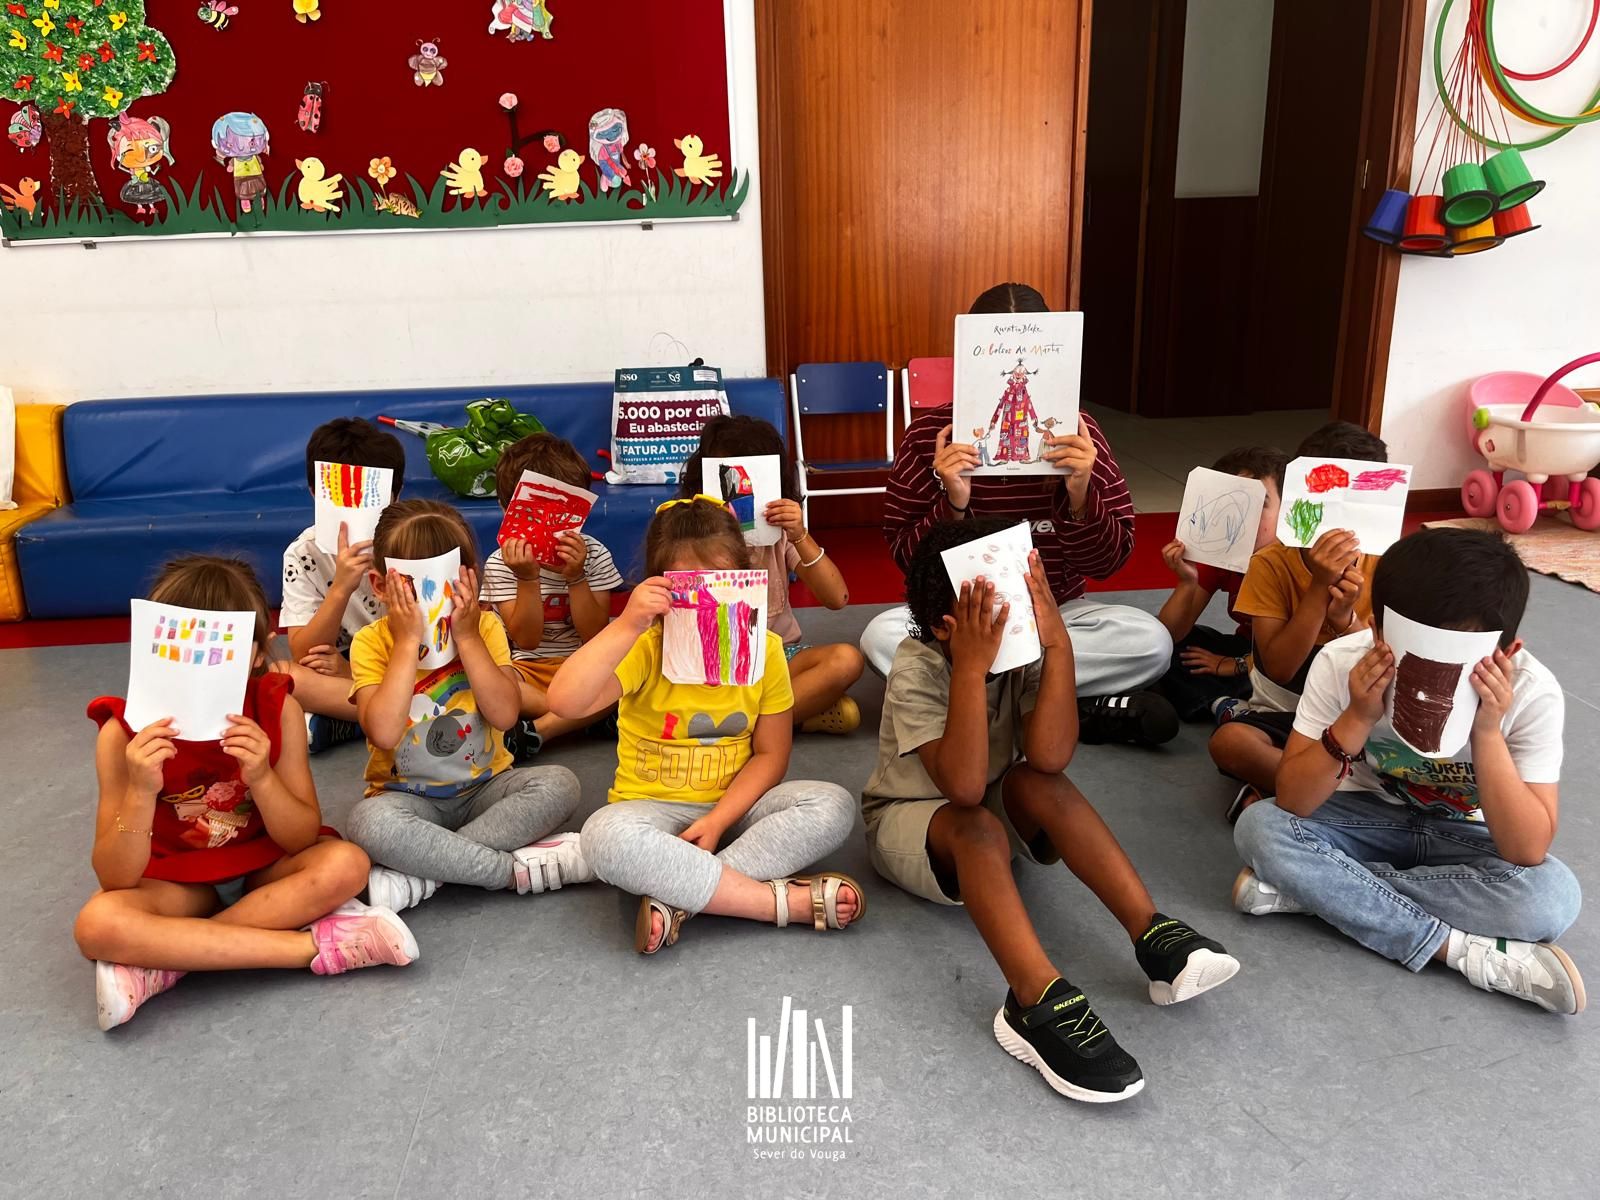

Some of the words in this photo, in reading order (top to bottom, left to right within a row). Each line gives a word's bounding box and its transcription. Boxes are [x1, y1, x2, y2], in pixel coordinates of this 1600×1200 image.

[1020, 323, 1043, 334] Blake
[973, 344, 985, 357] Os
[1030, 342, 1064, 356] Marta
[664, 406, 692, 421] por
[629, 423, 645, 433] Eu
[622, 444, 668, 455] FATURA
